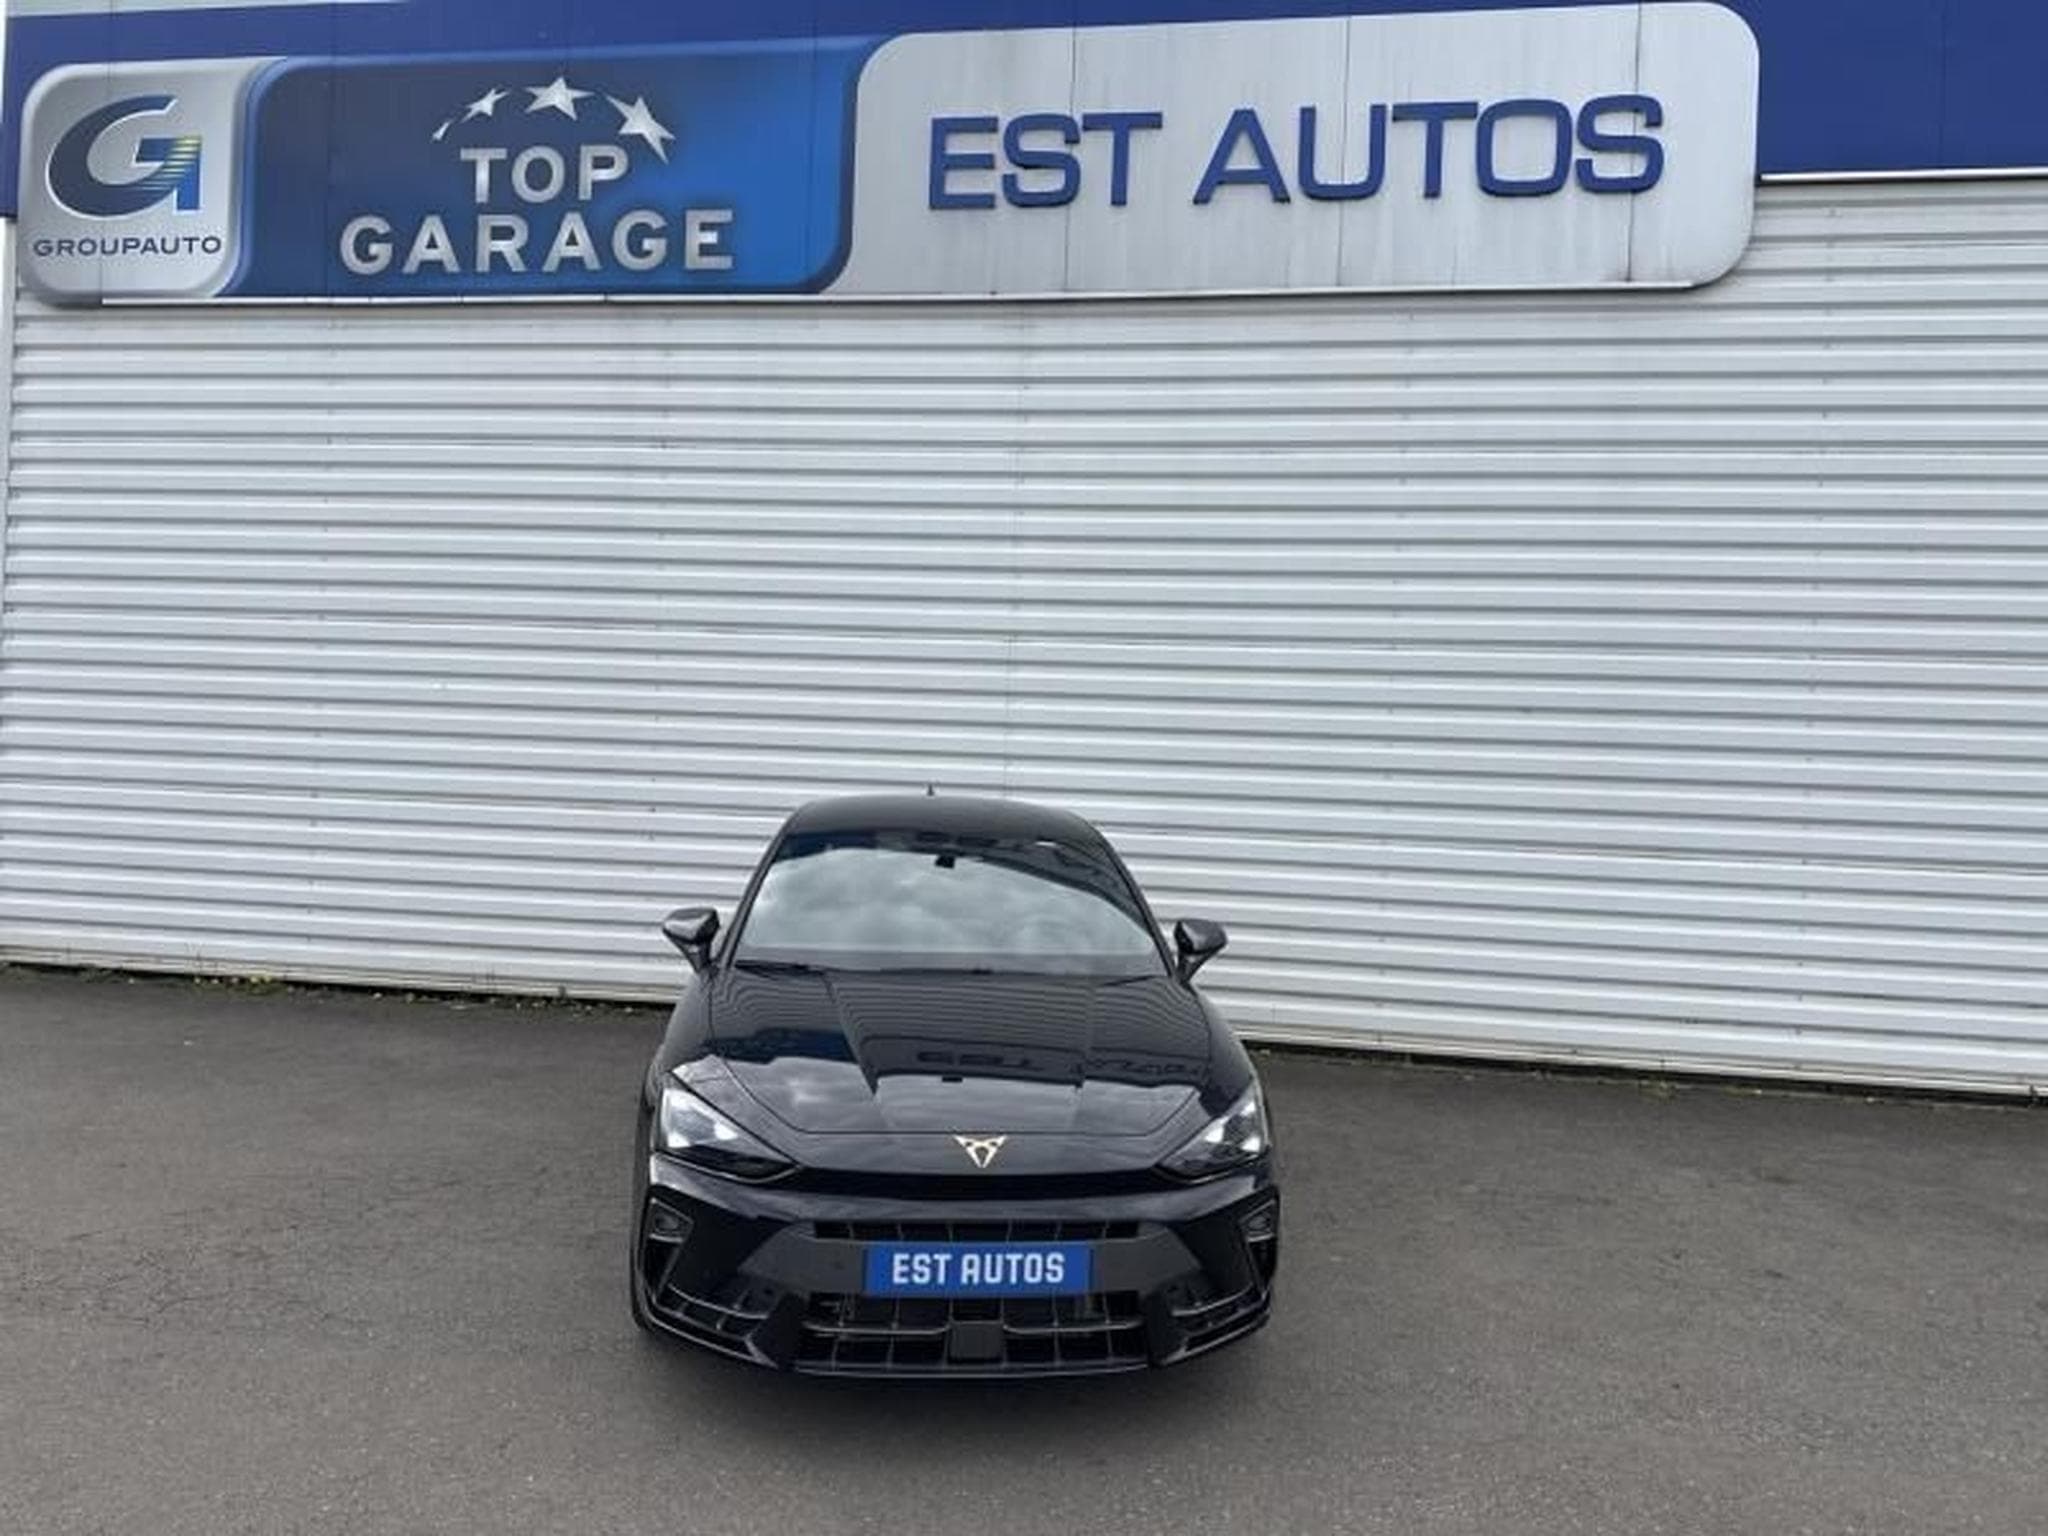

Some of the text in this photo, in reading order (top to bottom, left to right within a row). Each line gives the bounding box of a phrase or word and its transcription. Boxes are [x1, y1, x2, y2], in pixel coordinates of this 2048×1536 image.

[460, 145, 629, 203] TOP
[930, 94, 1665, 209] EST AUTOS
[34, 236, 222, 257] GROUPAUTO
[340, 209, 734, 275] GARAGE
[893, 1252, 1065, 1285] EST AUTOS
